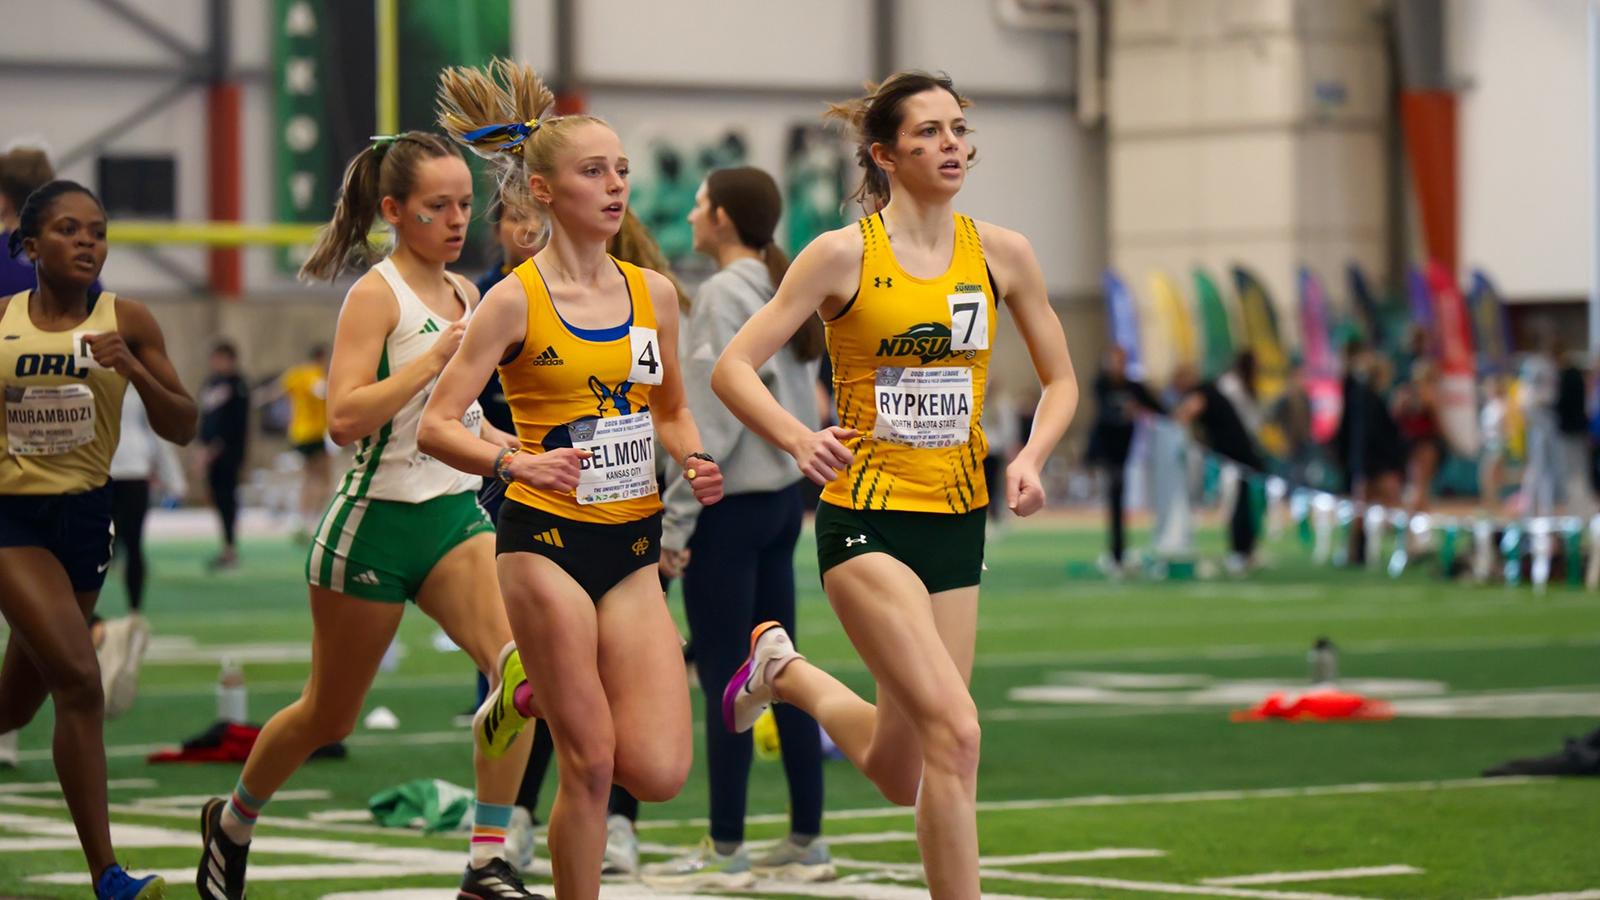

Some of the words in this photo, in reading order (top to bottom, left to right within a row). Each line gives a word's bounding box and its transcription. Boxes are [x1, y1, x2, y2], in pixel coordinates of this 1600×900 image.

[952, 302, 980, 344] 7
[876, 336, 952, 357] NDSU
[533, 358, 564, 366] adidas
[638, 340, 659, 374] 4
[879, 391, 969, 416] RYPKEMA
[7, 406, 92, 424] MURAMBIDZI
[891, 420, 911, 429] NORTH
[913, 420, 937, 429] DAKOTA
[938, 419, 957, 428] STATE
[606, 468, 630, 480] KANSAS
[630, 467, 641, 477] CITY
